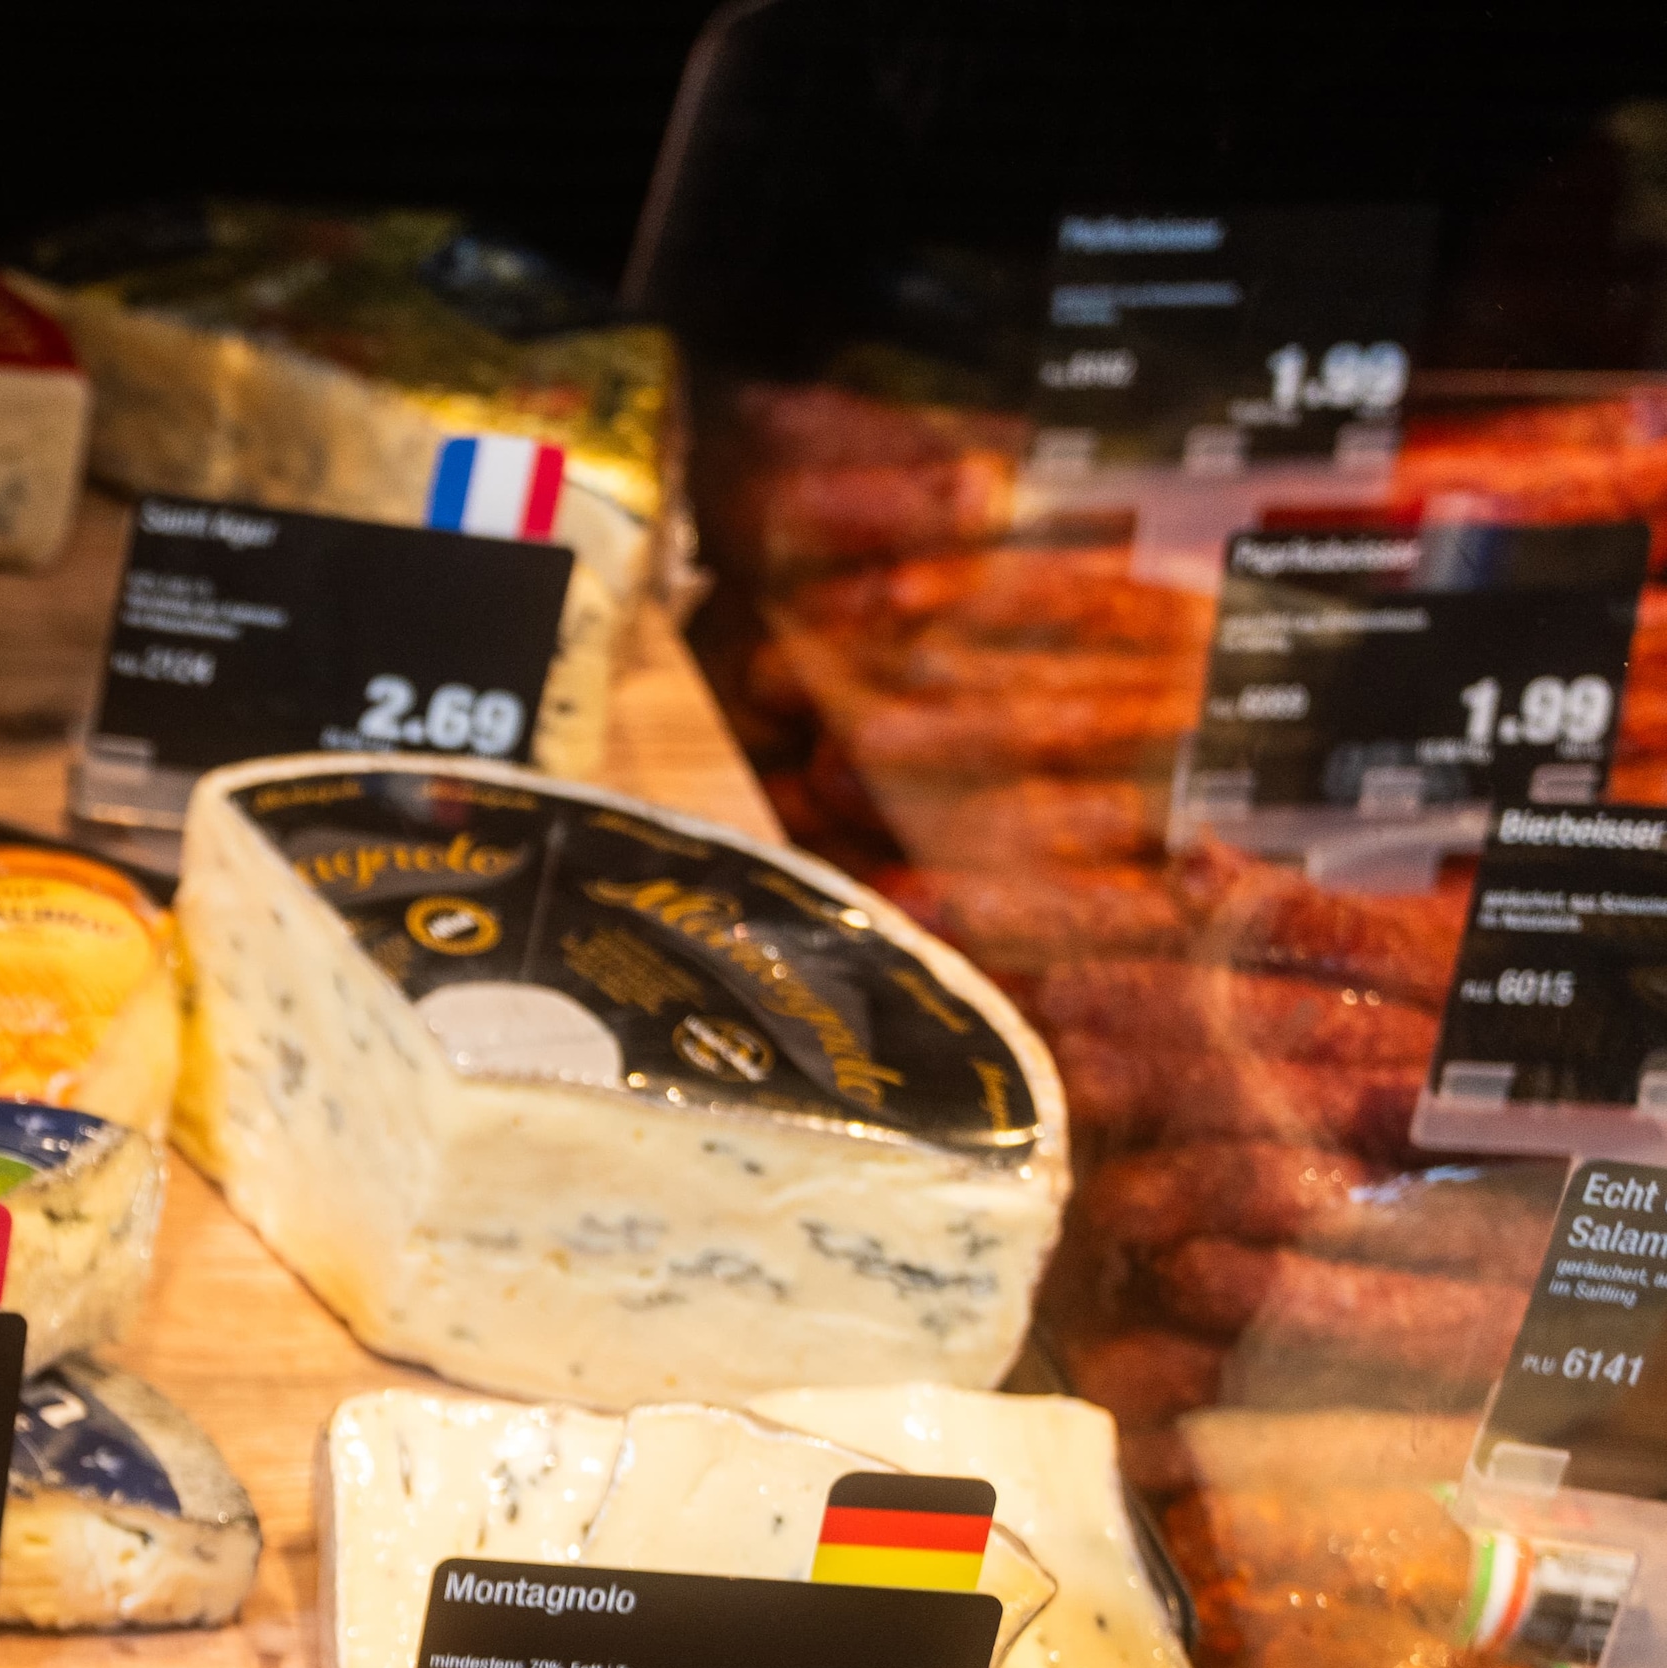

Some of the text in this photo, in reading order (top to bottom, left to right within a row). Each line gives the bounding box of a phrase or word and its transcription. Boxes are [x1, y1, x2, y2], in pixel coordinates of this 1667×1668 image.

[1268, 340, 1409, 409] 1.99
[357, 675, 525, 756] 2.69
[1461, 675, 1613, 745] 1.99
[1581, 1171, 1660, 1215] Echt
[1562, 1346, 1645, 1388] 6141
[445, 1573, 634, 1613] Montagnolo
